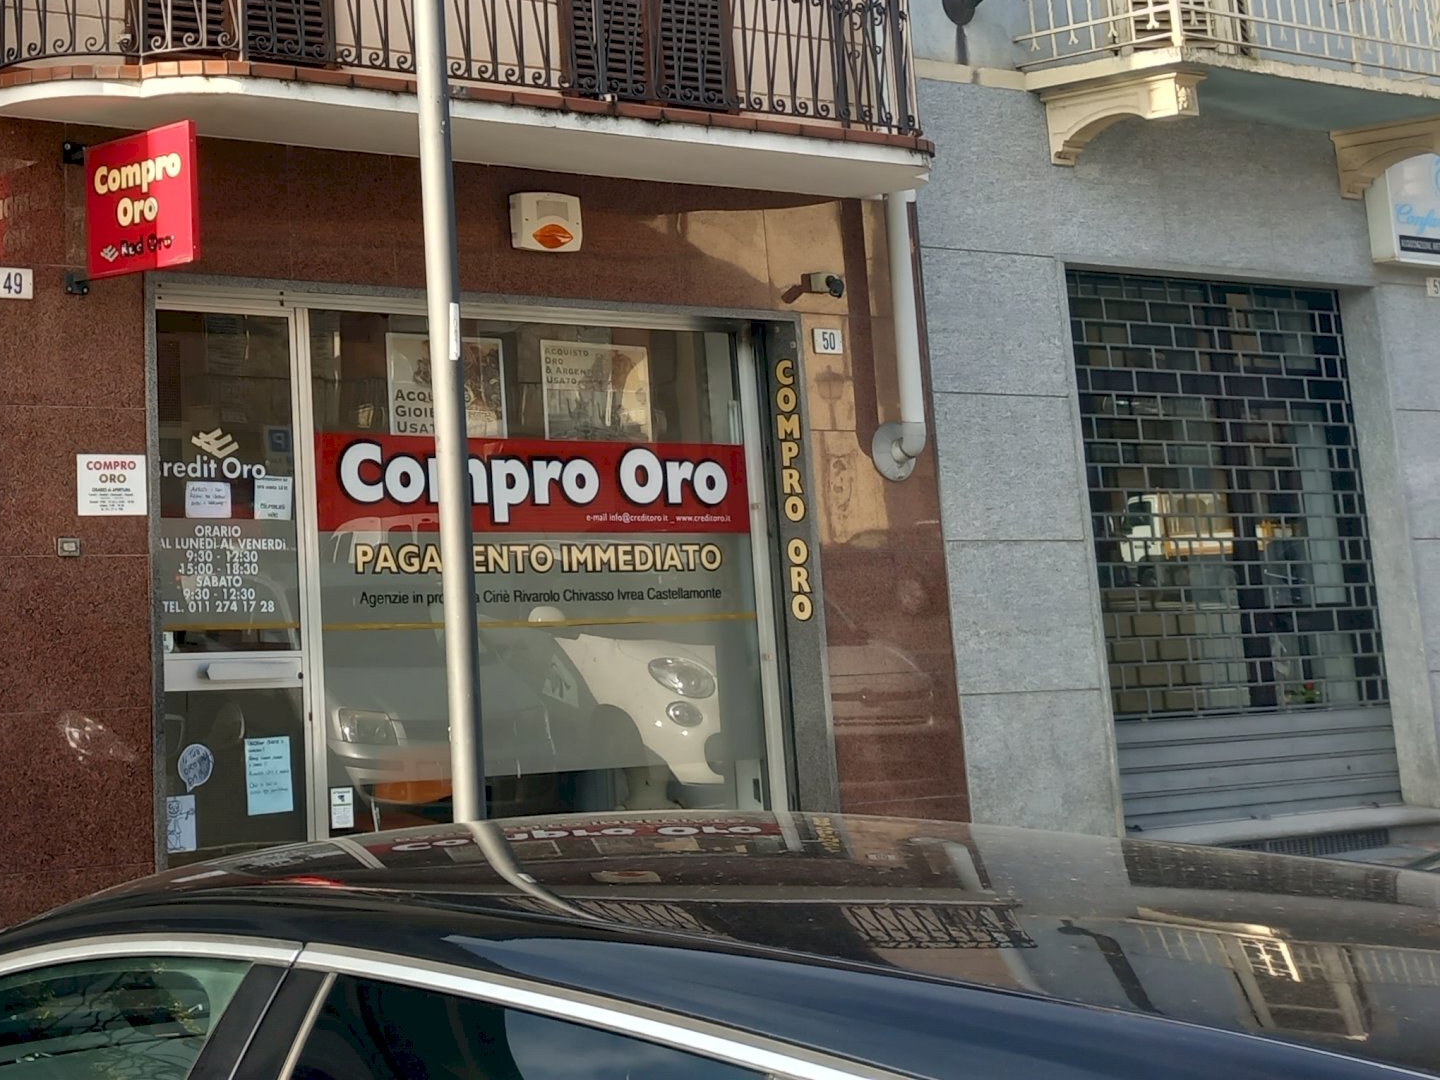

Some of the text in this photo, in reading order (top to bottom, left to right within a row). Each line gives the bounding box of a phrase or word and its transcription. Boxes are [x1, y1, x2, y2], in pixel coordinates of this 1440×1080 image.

[94, 152, 181, 195] Compro
[117, 197, 158, 227] Oro
[3, 272, 23, 295] 49
[822, 331, 836, 351] 50
[774, 358, 806, 522] COMPRO
[86, 461, 136, 470] COMPRO
[159, 454, 266, 479] redit Oro
[99, 474, 126, 483] ORO
[620, 448, 728, 505] Oro
[586, 513, 607, 521] e-mail
[194, 525, 241, 537] ORARIO
[220, 538, 234, 549] AL
[186, 550, 213, 562] 9:30
[226, 551, 258, 562] 12:30
[355, 543, 723, 574] PAGAENTO IMMEDIATO
[180, 563, 213, 575] 15:00
[226, 563, 258, 575] 18:30
[196, 575, 242, 587] SABATO
[787, 537, 812, 621] ORO
[183, 588, 210, 600] 9:30
[223, 588, 255, 600] 12:30
[360, 592, 409, 608] Agenzie
[413, 592, 423, 604] in
[514, 589, 559, 602] Rivarolo
[563, 588, 614, 601] Chivasso
[617, 588, 644, 600] Ivrea
[647, 587, 721, 600] Castellamonte
[162, 600, 275, 613] TEL. 011 274 17 28
